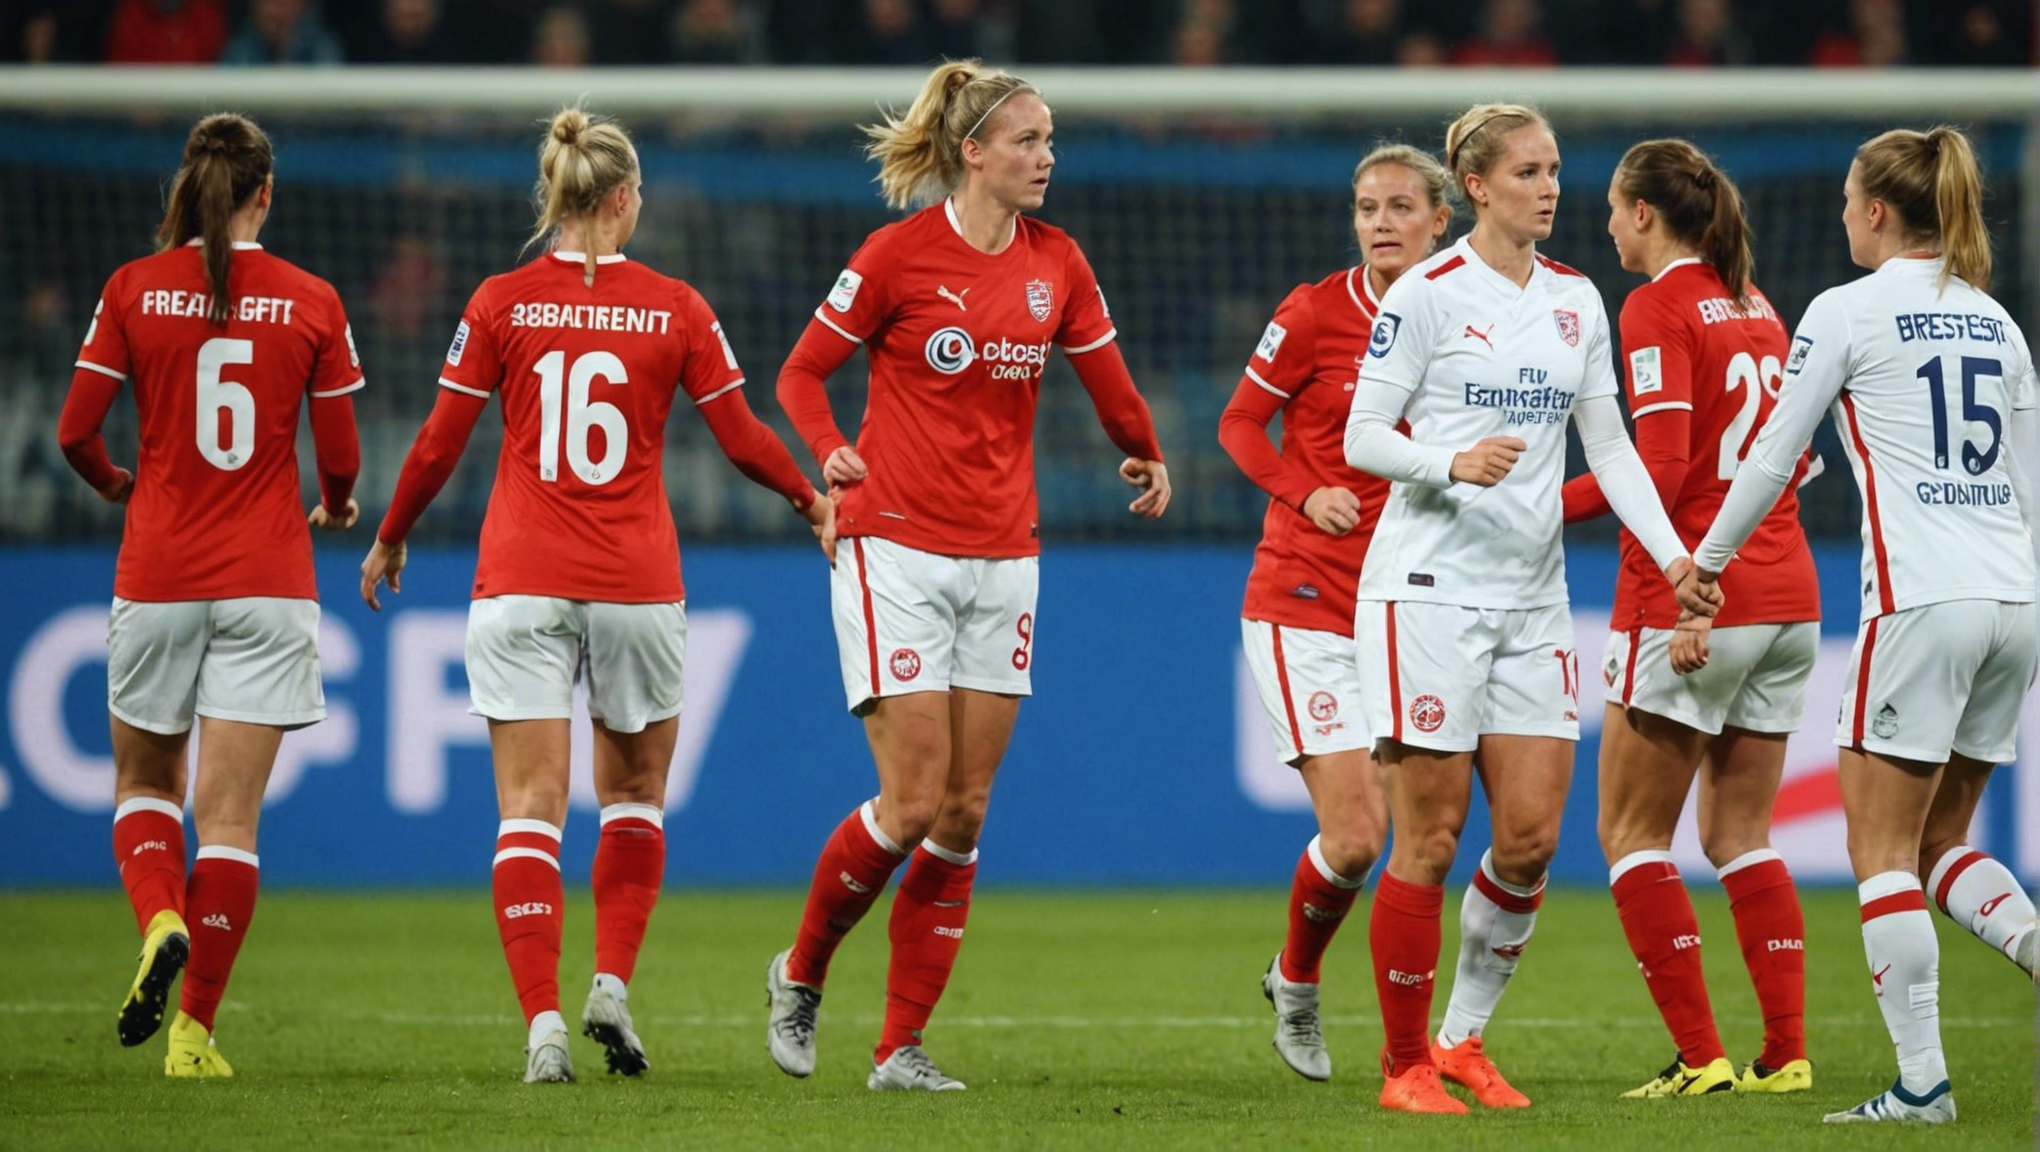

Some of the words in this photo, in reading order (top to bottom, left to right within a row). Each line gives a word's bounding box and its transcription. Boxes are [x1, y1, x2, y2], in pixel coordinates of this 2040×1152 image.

[196, 338, 255, 471] 6
[533, 351, 628, 485] 16
[1917, 355, 2002, 475] 15
